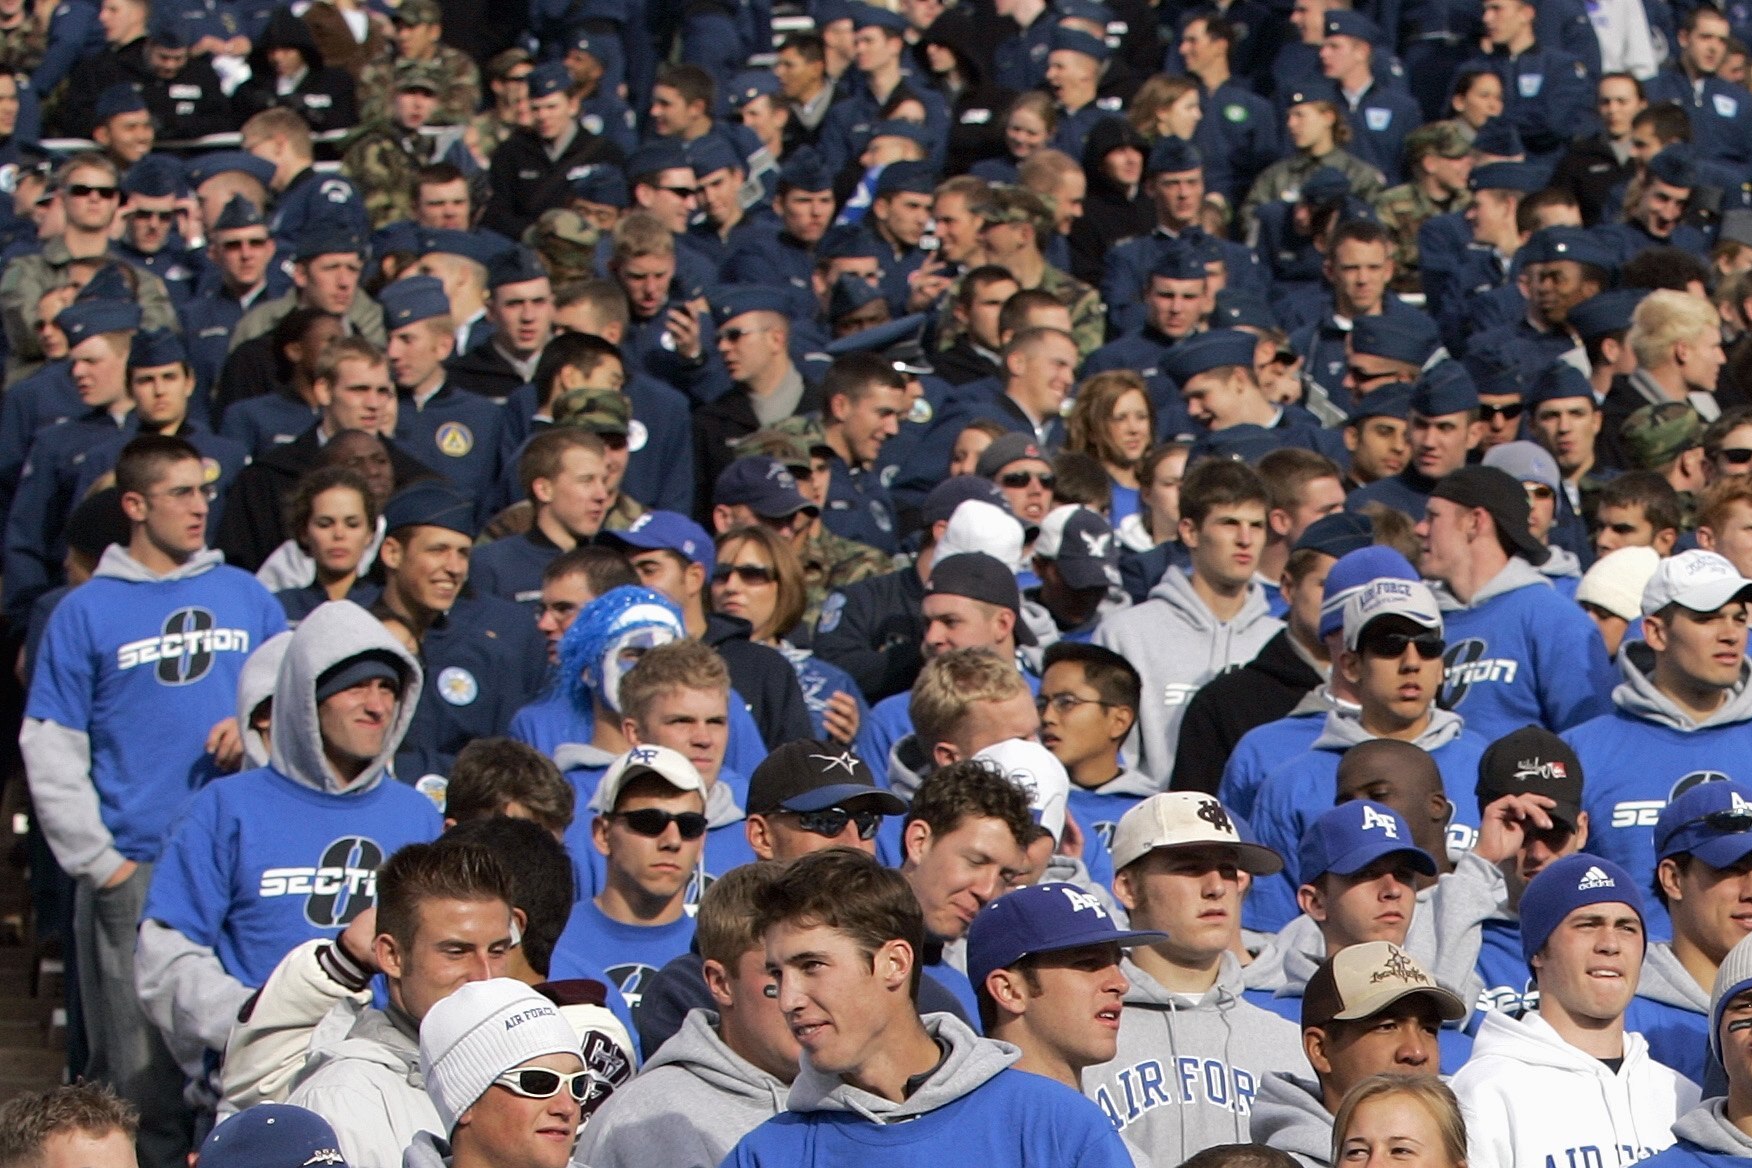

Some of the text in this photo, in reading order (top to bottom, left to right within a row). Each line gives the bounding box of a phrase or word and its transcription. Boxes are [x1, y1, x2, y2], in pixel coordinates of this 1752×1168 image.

[118, 629, 249, 670] SECTION
[1445, 658, 1519, 687] TION
[1362, 806, 1399, 838] AF
[260, 867, 378, 898] SECTI
[1072, 889, 1107, 919] AF
[504, 1006, 557, 1031] AIR FORCE
[1175, 1055, 1261, 1117] FOR
